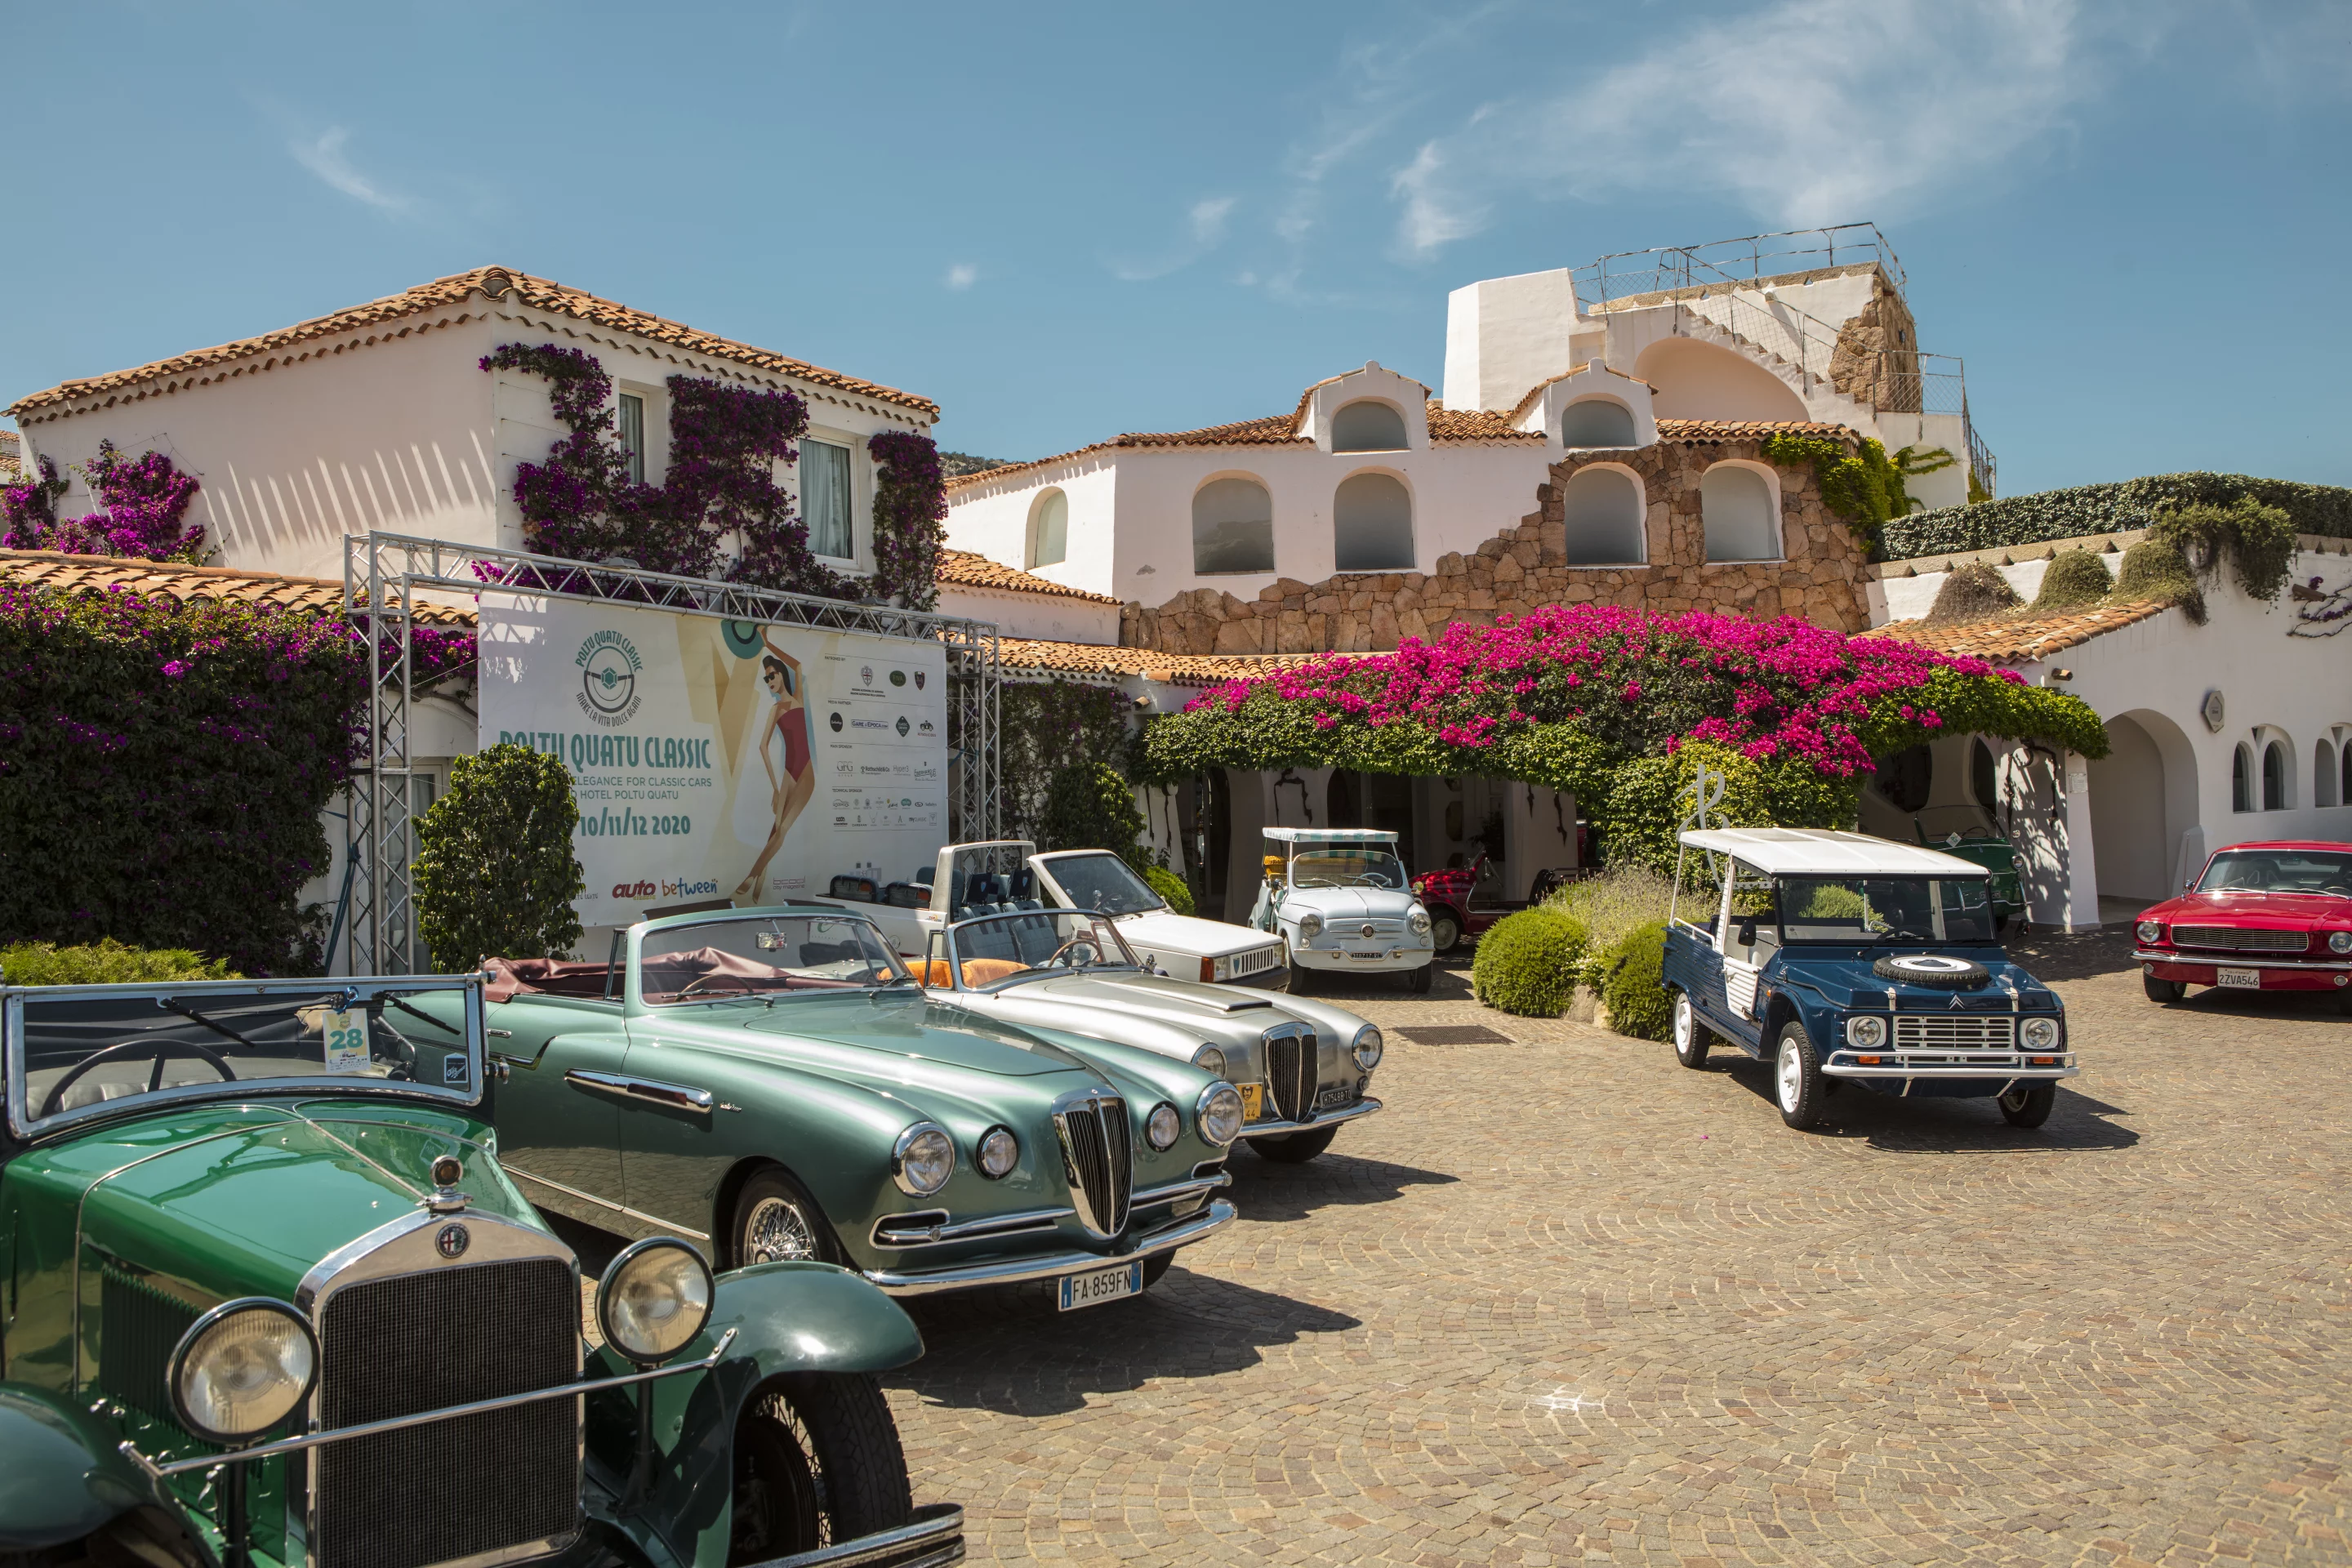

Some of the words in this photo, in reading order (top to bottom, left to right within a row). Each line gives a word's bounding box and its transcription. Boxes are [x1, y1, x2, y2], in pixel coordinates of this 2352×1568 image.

[575, 636, 595, 667] POLTU
[595, 630, 622, 647] QUATU
[621, 638, 644, 672] CLASSIC
[577, 693, 592, 715] MAKE
[589, 710, 598, 721] LA
[598, 715, 610, 727] VITA
[611, 711, 630, 727] DOLCE
[628, 696, 642, 718] AGAIN
[571, 733, 639, 773] QUATU
[644, 737, 710, 768] CLASSIC
[627, 777, 645, 786] FOR
[648, 777, 686, 786] CLASSIC
[688, 777, 712, 786] CARS
[581, 790, 612, 799] HOTEL
[615, 790, 644, 799] POLTU
[648, 790, 679, 800] QUATU
[580, 807, 648, 836] 10/11/12
[652, 815, 691, 835] 2020
[612, 880, 656, 898] auto
[662, 877, 717, 898] between
[2219, 974, 2259, 986] 2ZVA546
[330, 1028, 363, 1050] 28
